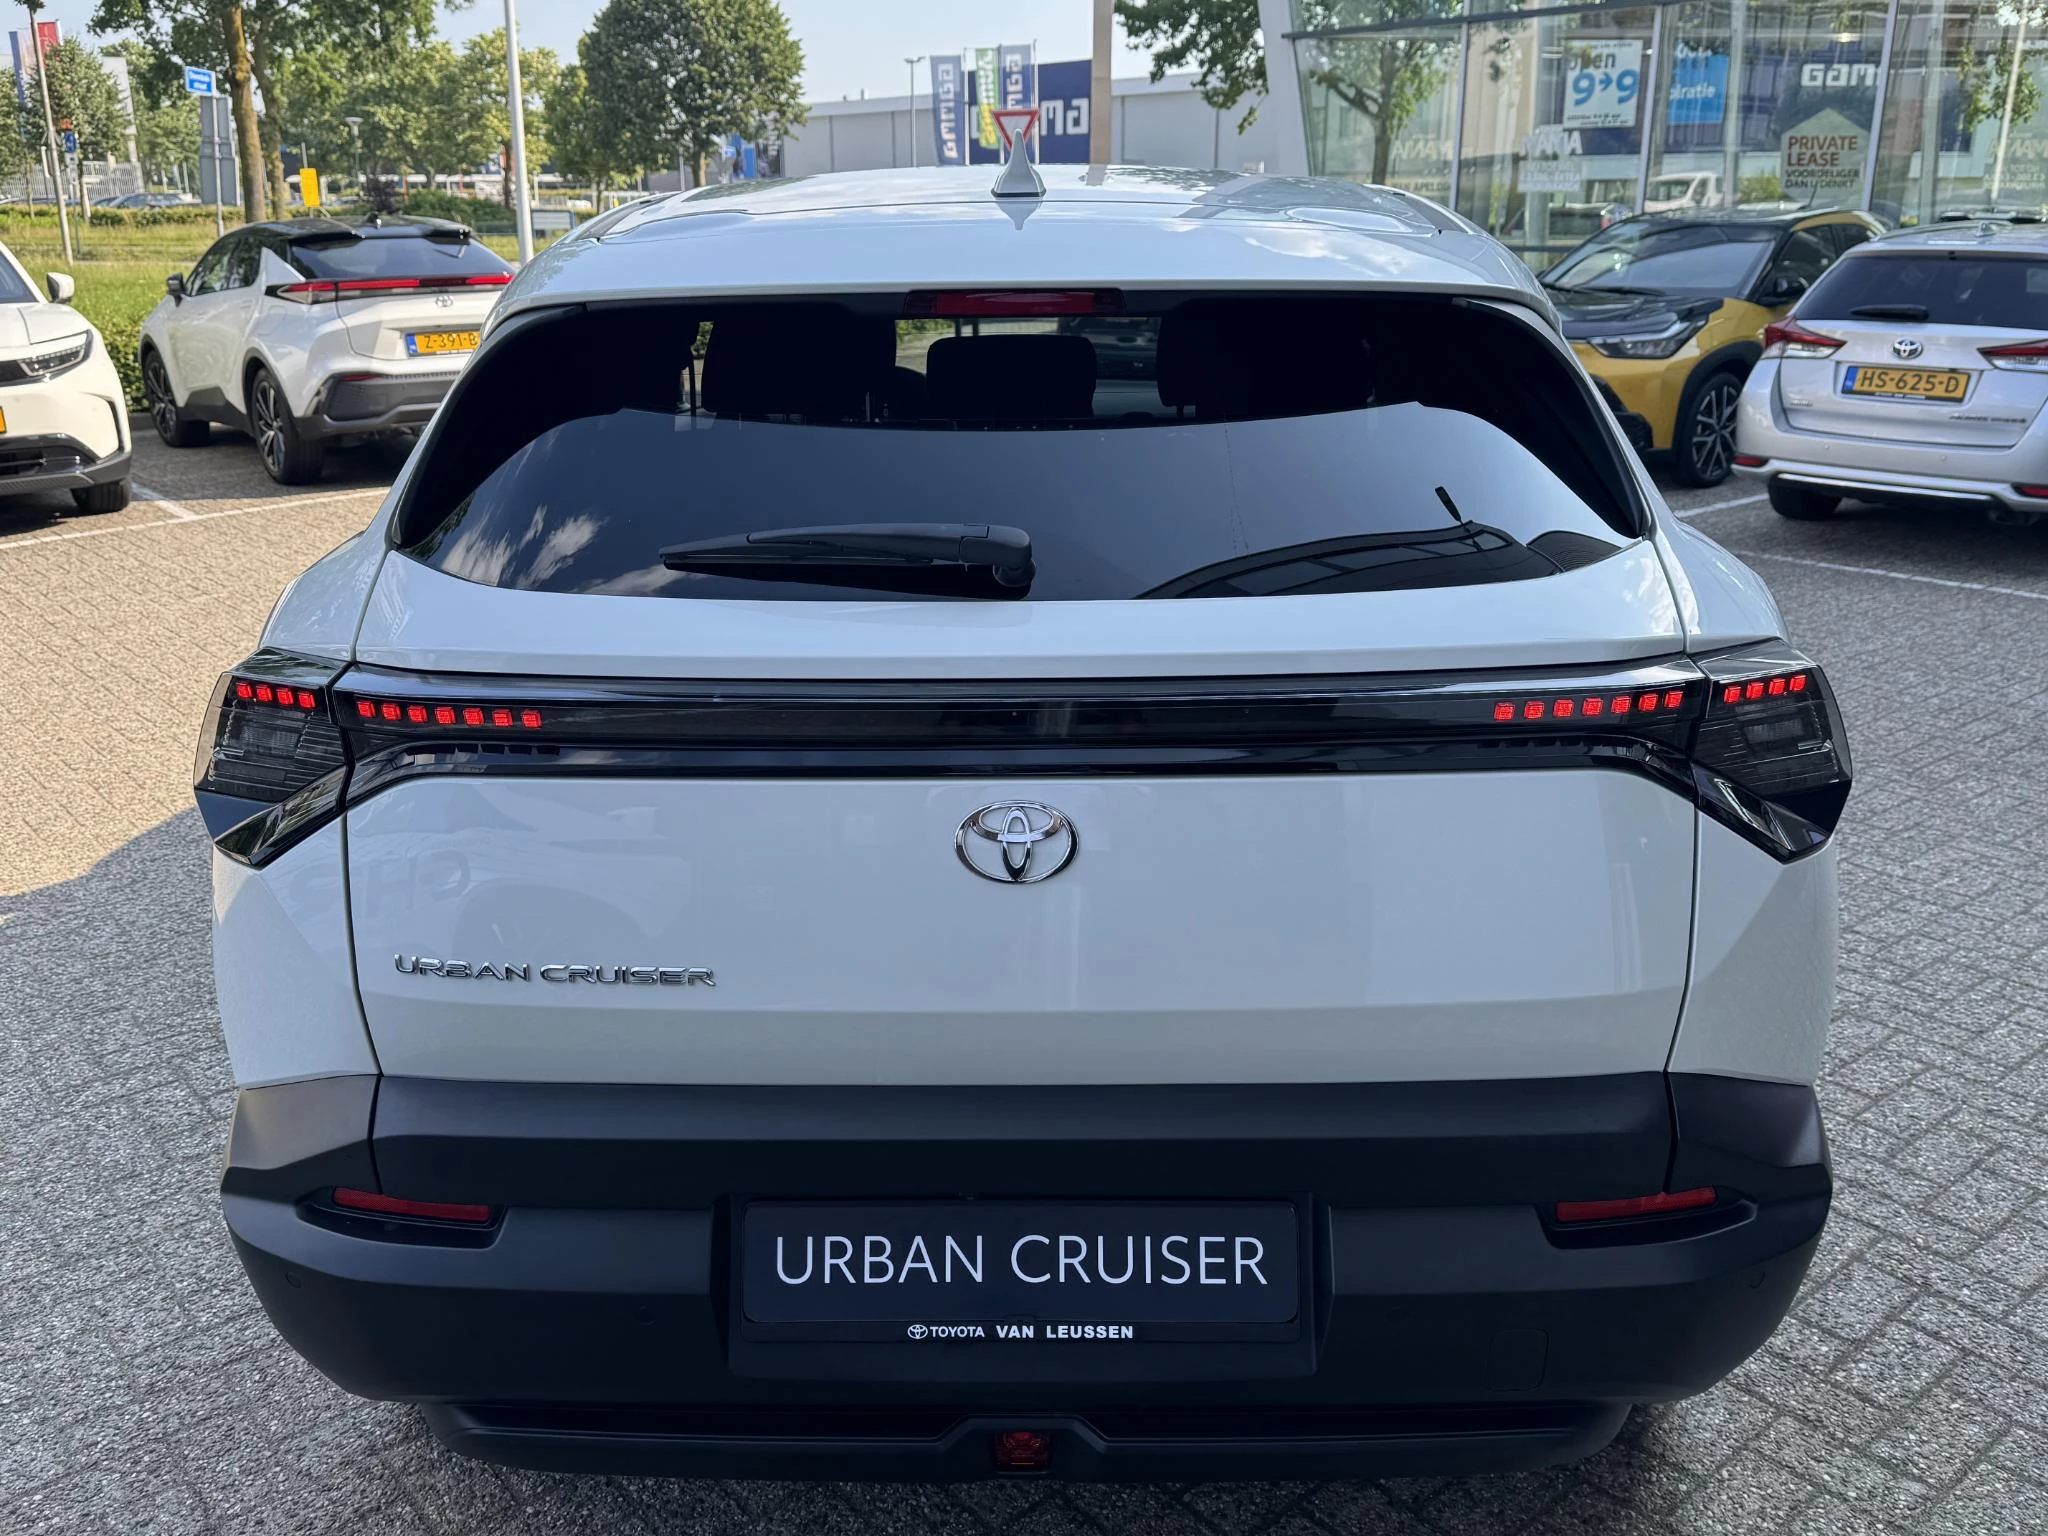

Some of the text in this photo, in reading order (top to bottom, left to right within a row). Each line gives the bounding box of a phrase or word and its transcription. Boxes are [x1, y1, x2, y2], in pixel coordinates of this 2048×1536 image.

[1788, 135, 1858, 151] PRIVATE
[1787, 152, 1840, 167] LEASE
[1860, 370, 1960, 394] HS-625-D
[393, 953, 717, 987] URBAN CRUISER
[776, 1234, 1268, 1285] URBAN CRUISER
[929, 1325, 1134, 1339] TOYOTA VAN LEUSSEN
